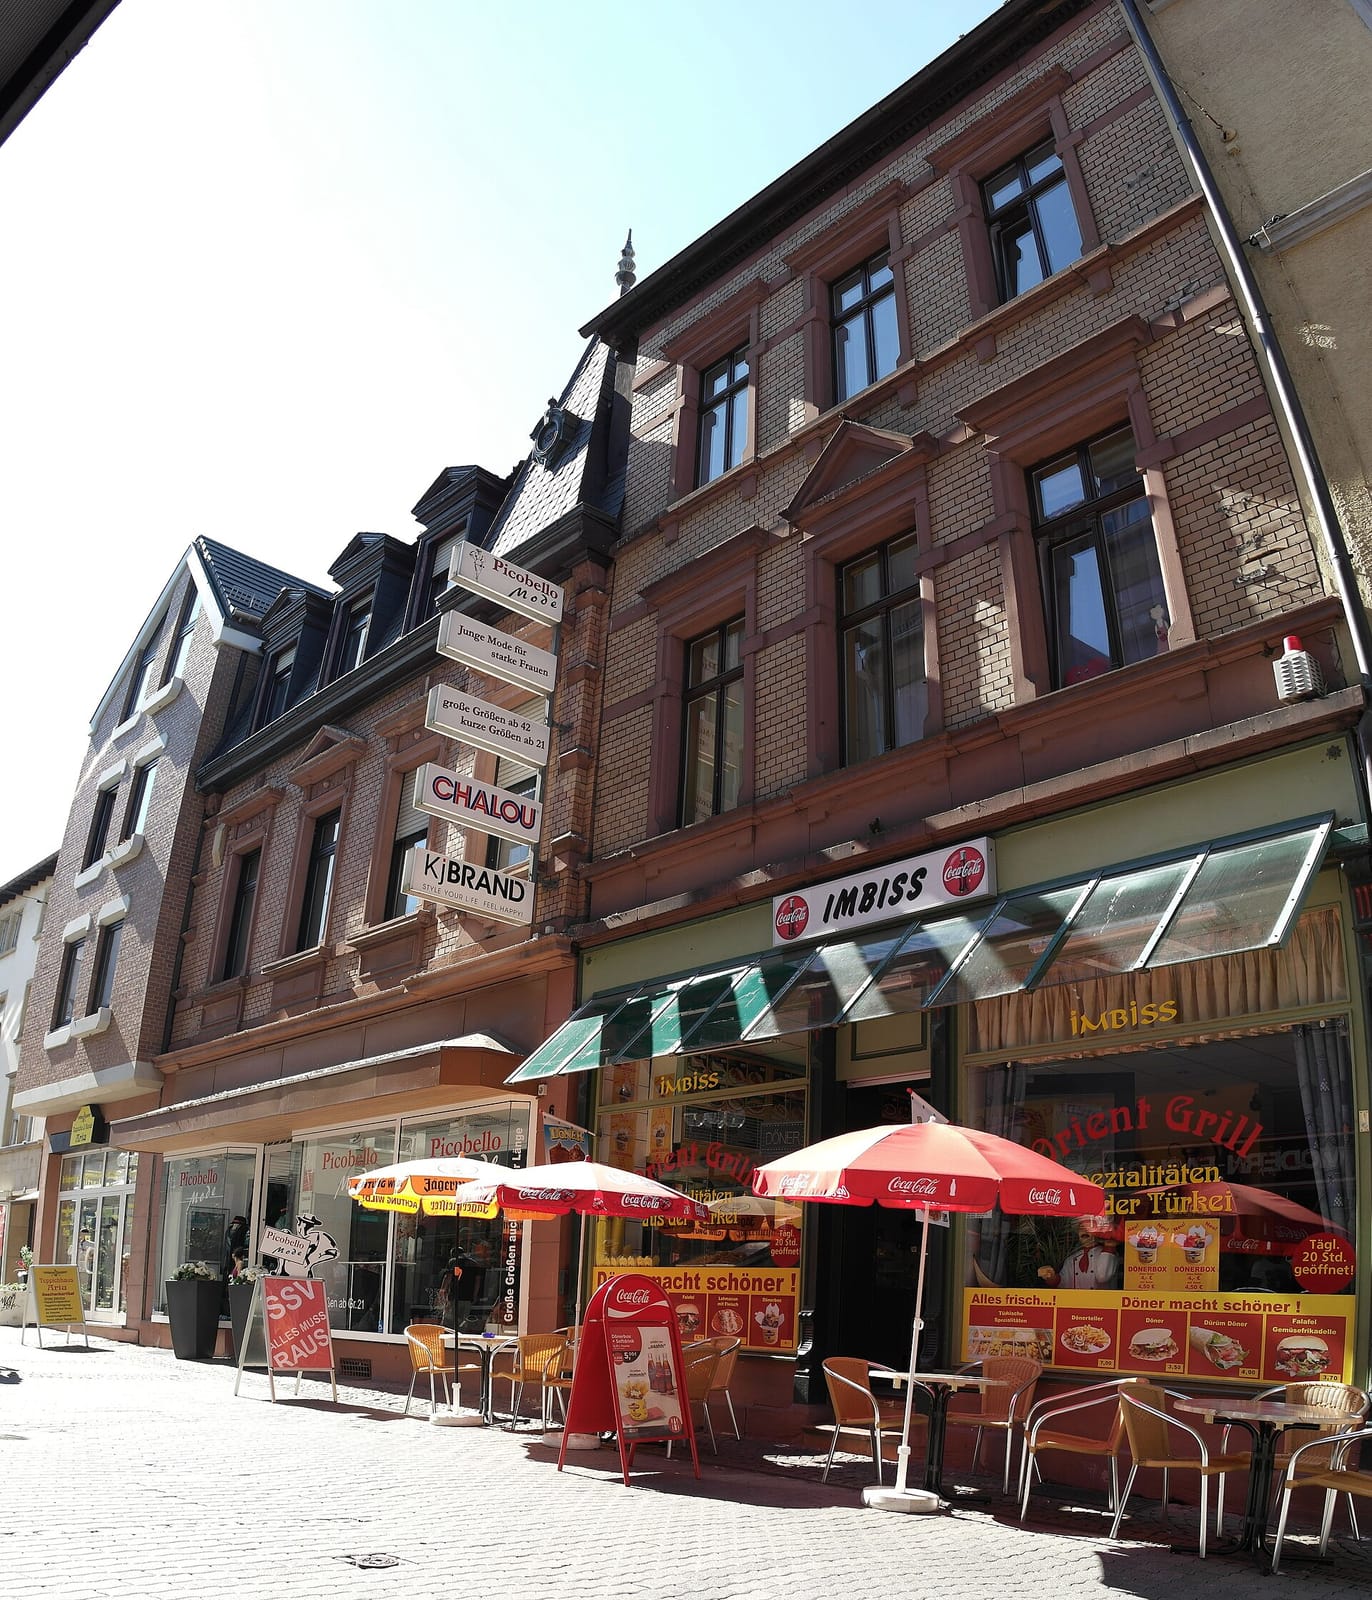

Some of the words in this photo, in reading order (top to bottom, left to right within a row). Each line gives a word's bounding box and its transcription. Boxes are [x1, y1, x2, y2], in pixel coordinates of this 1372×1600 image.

[492, 557, 559, 600] Picobello
[508, 587, 558, 609] Mode
[457, 624, 486, 643] Junge
[487, 634, 513, 652] Mode
[514, 645, 528, 657] für
[490, 650, 518, 666] starke
[519, 659, 549, 677] Frauen
[442, 699, 471, 713] große
[472, 706, 506, 724] Größen
[508, 718, 519, 728] ab
[520, 722, 531, 732] 42
[460, 716, 487, 731] kurze
[488, 724, 521, 742] Größen
[523, 736, 534, 746] ab
[535, 739, 545, 750] 21
[432, 775, 537, 830] CHALOU
[944, 857, 985, 883] Coca-Cola
[422, 883, 441, 895] STYLE
[444, 889, 464, 901] YOUR
[483, 900, 498, 911] FEEL
[822, 866, 928, 924] IMBISS
[776, 905, 809, 927] Coca-Cola
[1164, 1095, 1264, 1158] Grill
[430, 1130, 502, 1158] Picobello
[511, 1127, 525, 1162] Länge
[321, 1146, 379, 1170] Picobello
[179, 1169, 218, 1187] Picobello
[887, 1176, 937, 1195] Coca-Cola
[518, 1187, 561, 1201] Coca-Cola
[621, 1193, 660, 1210] Coca-Cola
[1028, 1187, 1062, 1205] Coca-Cola
[1104, 1193, 1141, 1216] der
[1146, 1188, 1233, 1215] Türkei
[266, 1230, 306, 1250] Picobello
[779, 1229, 795, 1239] Tägl.
[785, 1238, 798, 1247] Std.
[271, 1245, 303, 1257] Mode
[1308, 1239, 1341, 1252] Tägl.
[504, 1245, 517, 1286] Größen
[1302, 1252, 1321, 1263] 20
[1322, 1252, 1347, 1263] Std.
[1293, 1263, 1355, 1277] geöffnet!
[706, 1273, 785, 1292] schöner
[790, 1273, 797, 1293] !
[265, 1280, 317, 1321] SSV
[338, 1297, 347, 1309] ab
[503, 1288, 515, 1322] Große
[616, 1288, 650, 1304] Coca-Cola
[971, 1293, 1002, 1305] Alles
[1005, 1293, 1057, 1306] frisch...!
[1121, 1296, 1164, 1310] Döner
[1169, 1299, 1218, 1311] macht
[1223, 1300, 1291, 1313] schöner
[1296, 1301, 1301, 1313] !
[1071, 1314, 1104, 1322] Dönerteller
[1145, 1316, 1166, 1324] Döner
[1203, 1319, 1226, 1327] Dürüm
[1227, 1320, 1248, 1328] Döner
[270, 1327, 300, 1351] ALLES
[300, 1310, 327, 1334] MUSS
[1272, 1326, 1337, 1335] Gemüsefrikadelle
[273, 1328, 330, 1368] RAUS
